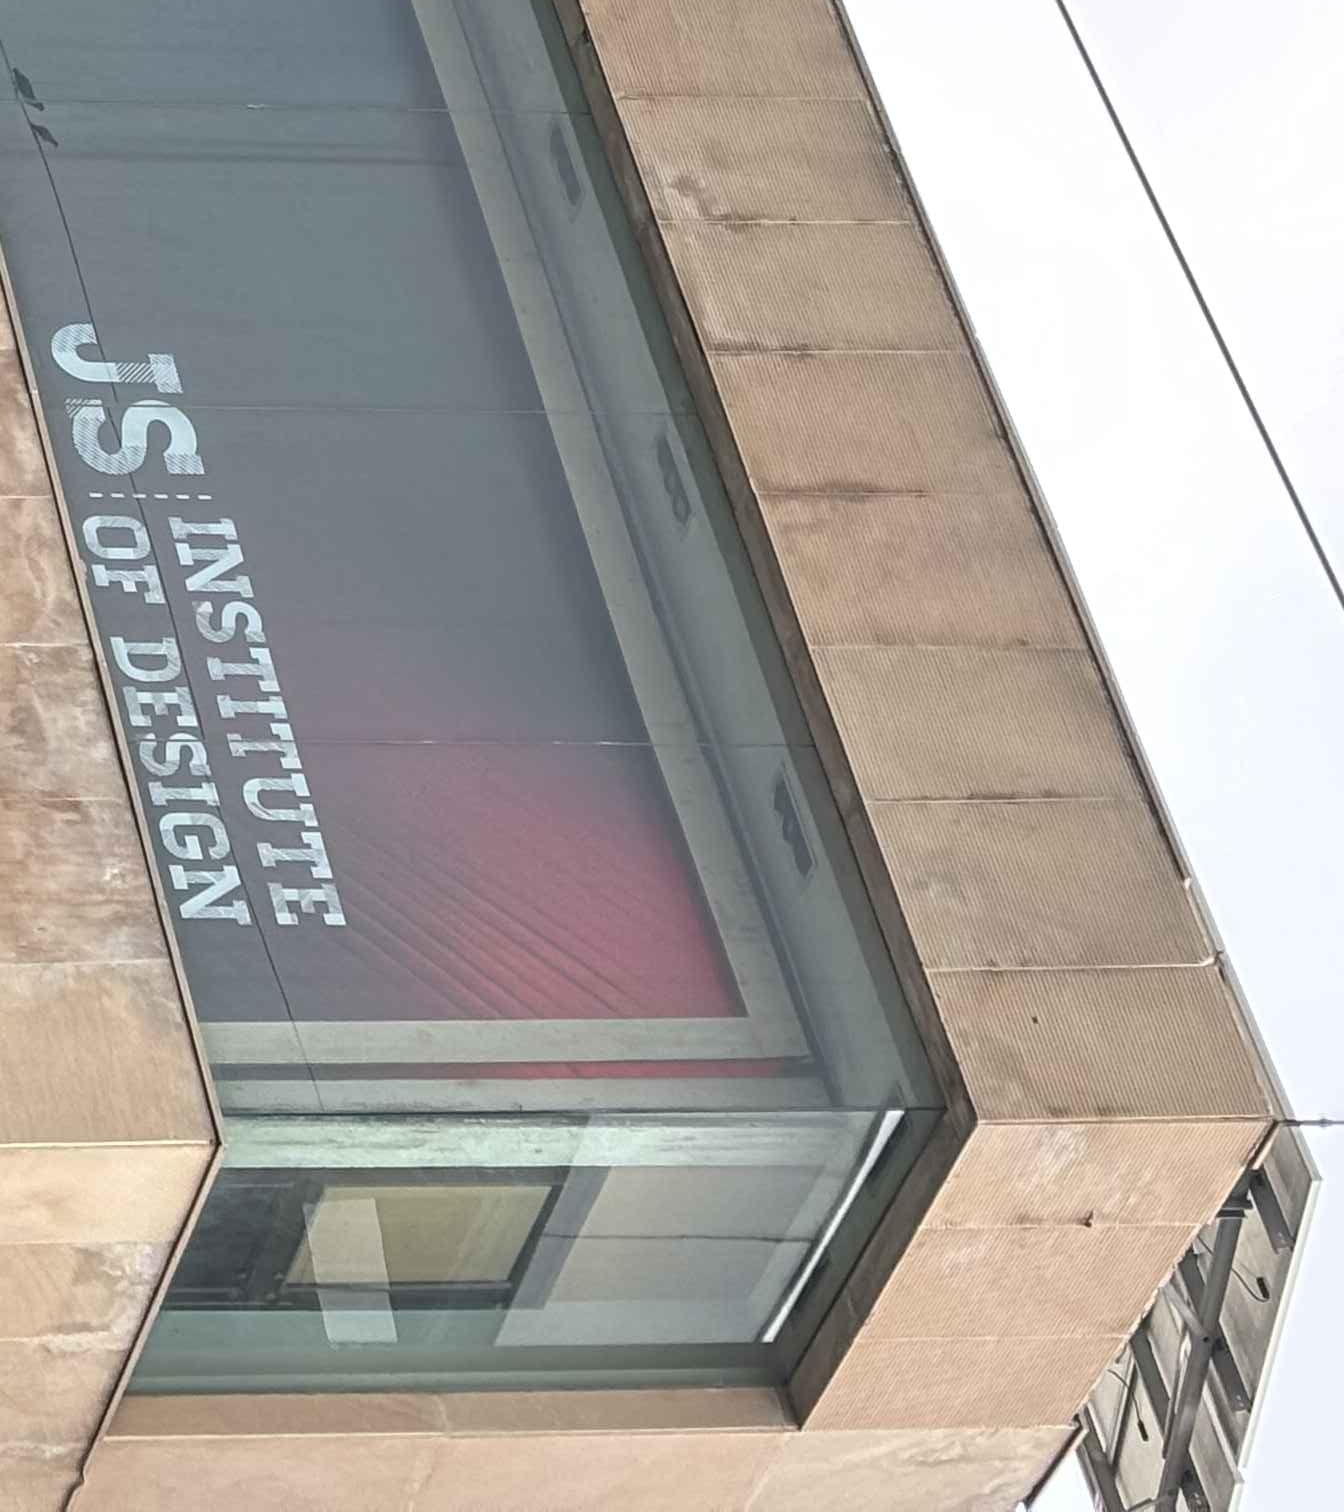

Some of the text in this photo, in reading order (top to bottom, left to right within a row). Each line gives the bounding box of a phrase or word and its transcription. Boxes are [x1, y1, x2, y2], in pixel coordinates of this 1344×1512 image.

[50, 323, 205, 476] JS
[82, 515, 252, 925] OF DESIGN
[169, 516, 347, 926] INSTITUTE
